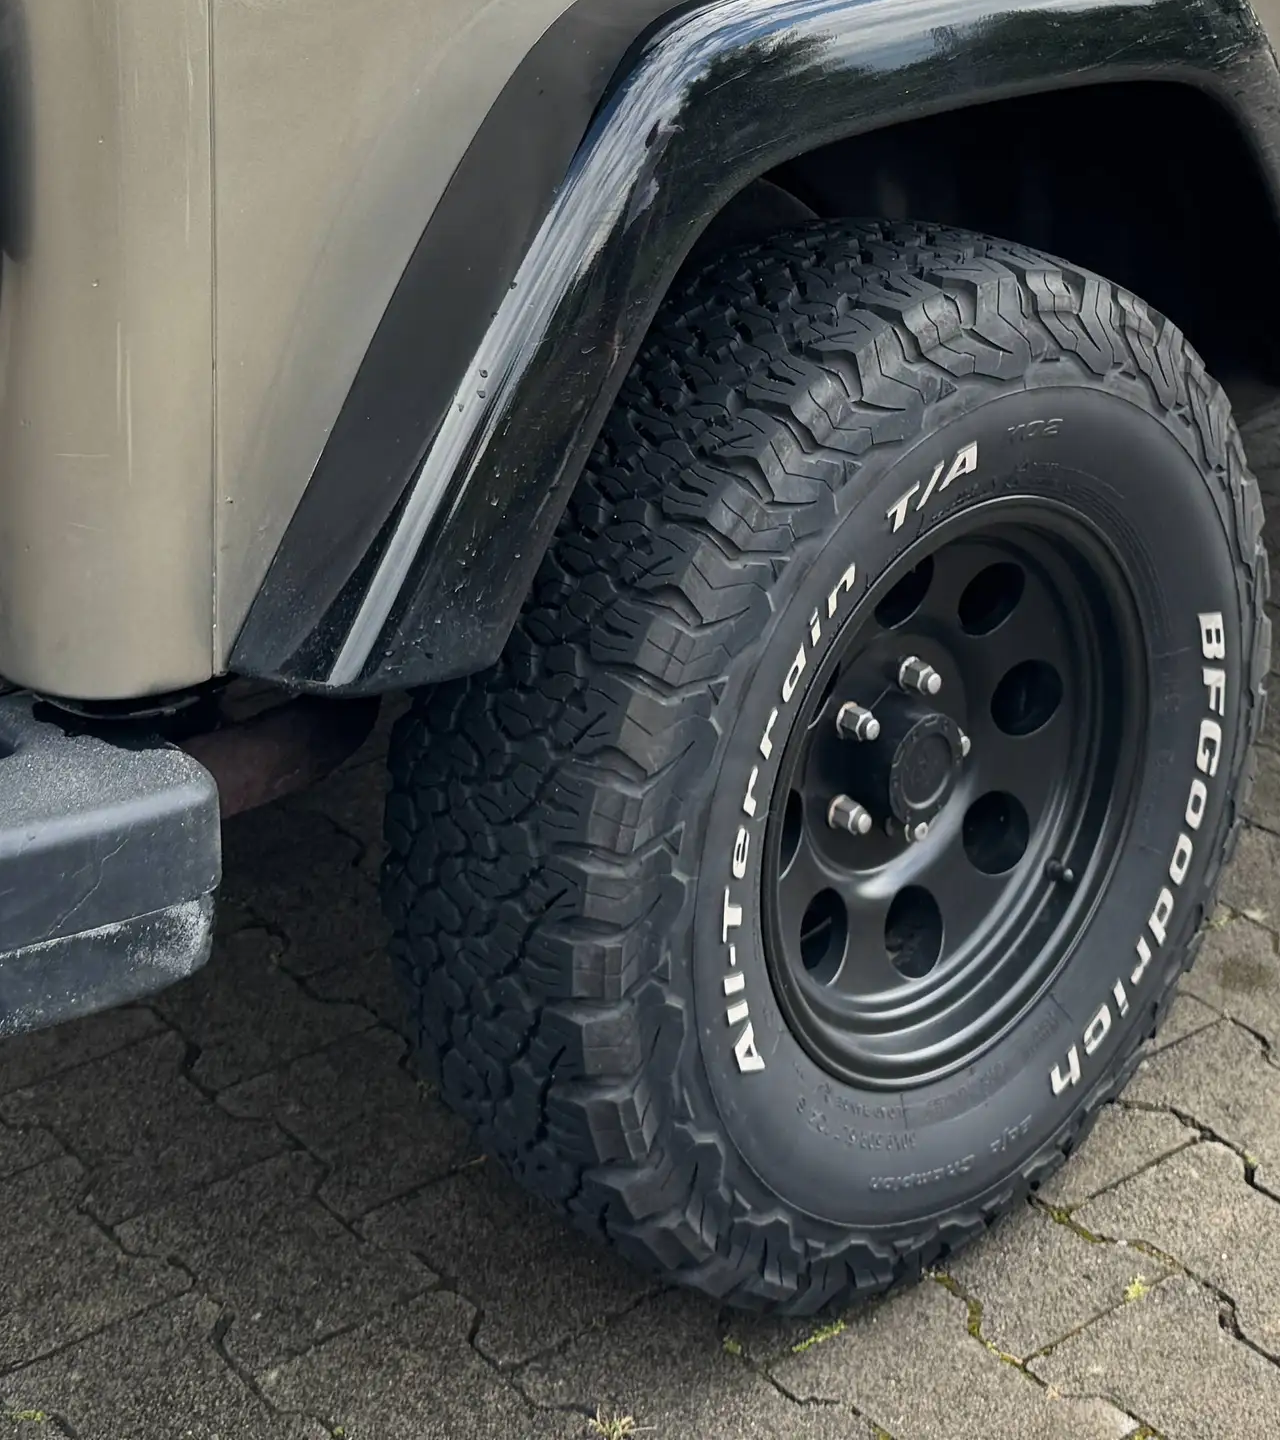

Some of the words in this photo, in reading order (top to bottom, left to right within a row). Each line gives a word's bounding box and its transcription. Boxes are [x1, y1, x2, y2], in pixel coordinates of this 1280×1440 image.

[885, 440, 979, 534] T/A
[721, 562, 857, 1074] All-Terrain
[1048, 610, 1231, 1097] BFGoodrich
